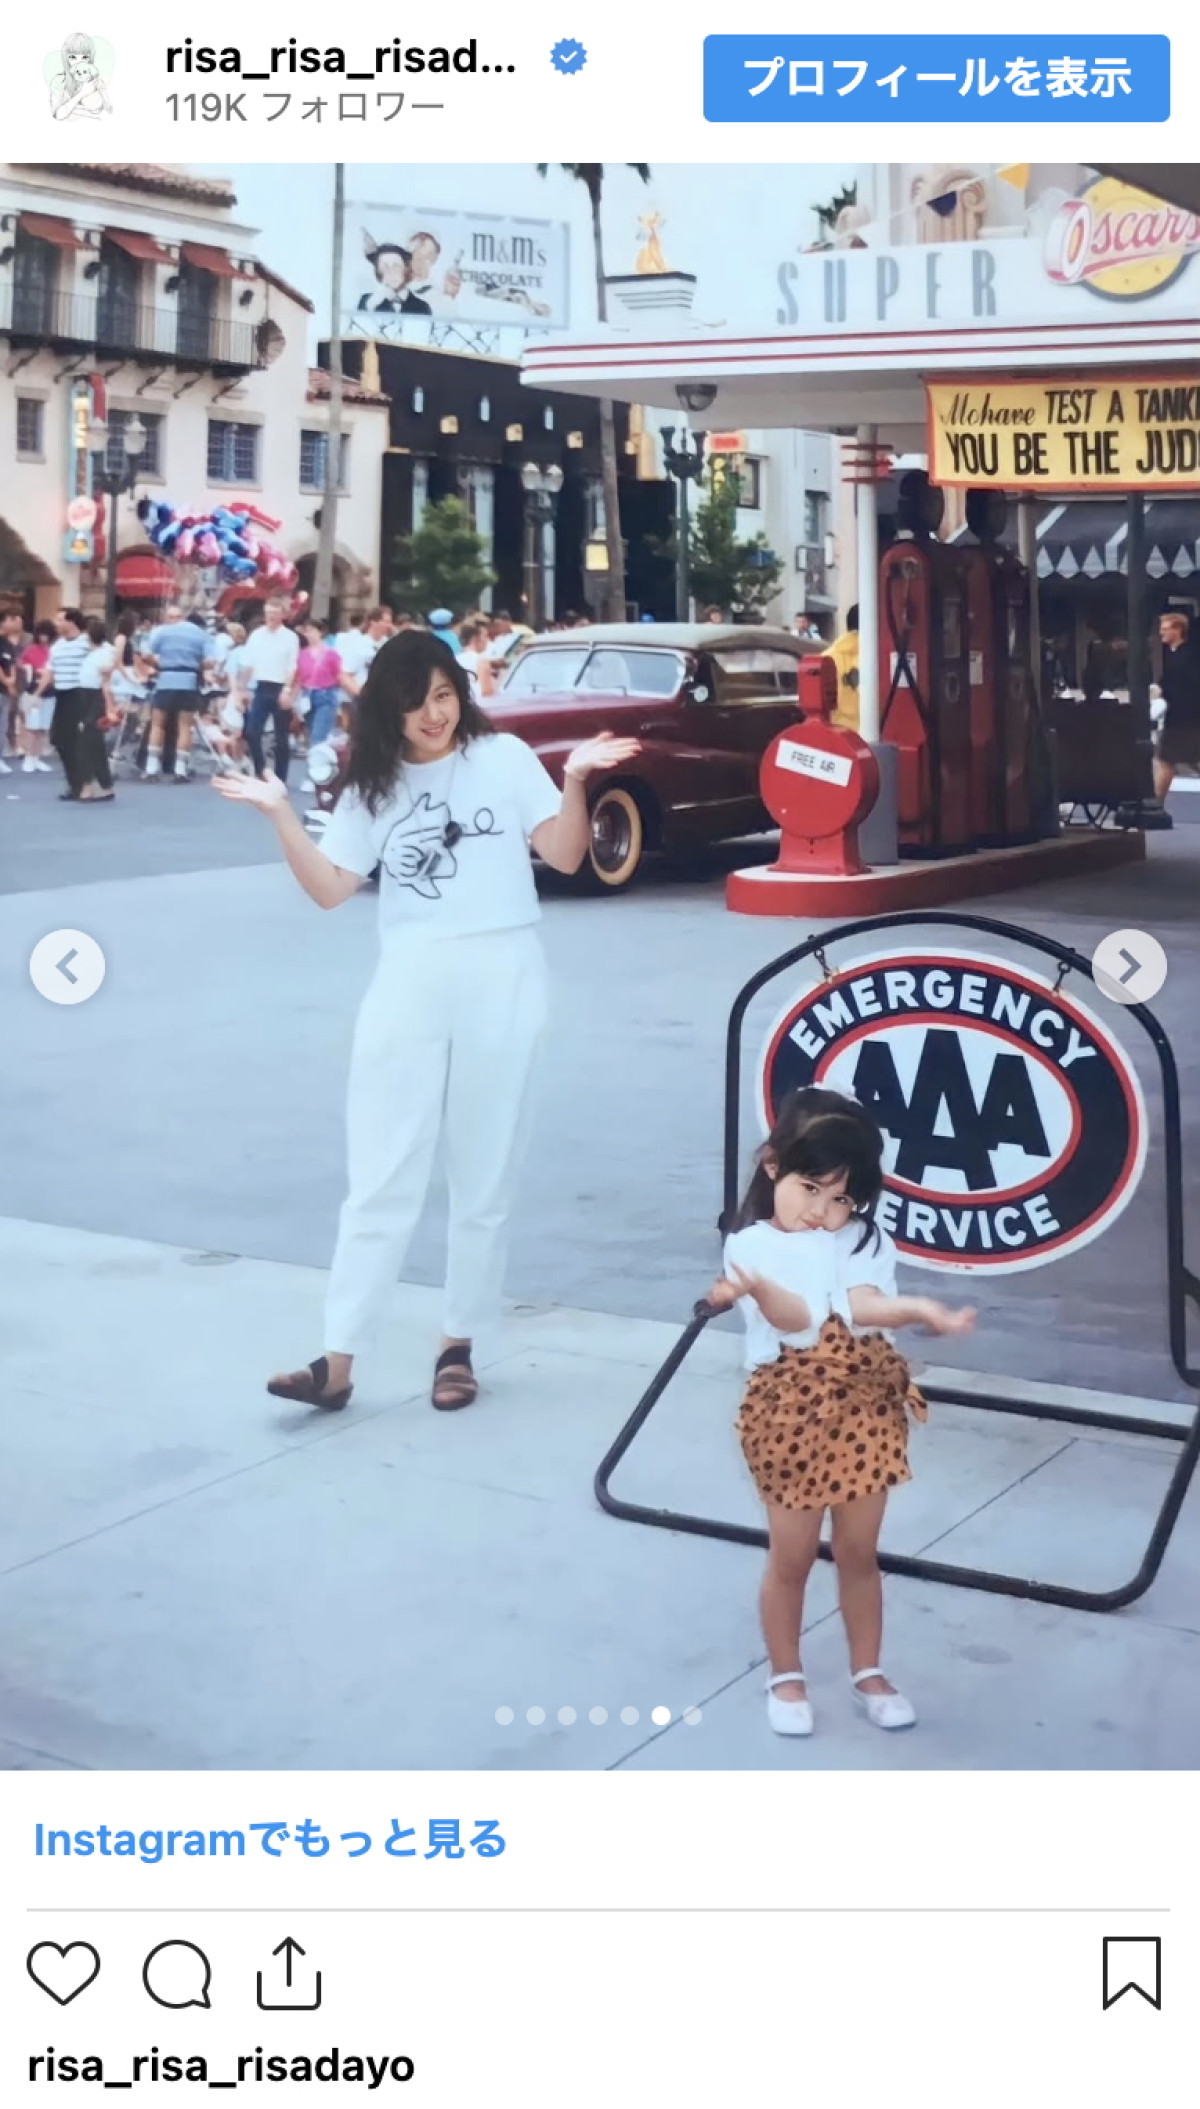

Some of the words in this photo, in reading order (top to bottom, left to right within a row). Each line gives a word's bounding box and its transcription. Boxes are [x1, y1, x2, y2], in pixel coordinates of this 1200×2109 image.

[777, 249, 996, 325] SUPER
[940, 393, 1036, 426] Mohave
[1045, 389, 1097, 424] TEST
[1106, 389, 1125, 424] A
[1134, 386, 1200, 424] TANK
[946, 432, 998, 475] YOU
[1013, 432, 1049, 476] BE
[1064, 430, 1121, 475] THE
[1136, 428, 1200, 474] JUD
[791, 750, 815, 769] FREE
[789, 970, 1098, 1068] EMERGENCY
[850, 1028, 1051, 1191] AAA
[873, 1190, 1060, 1249] ERVICE
